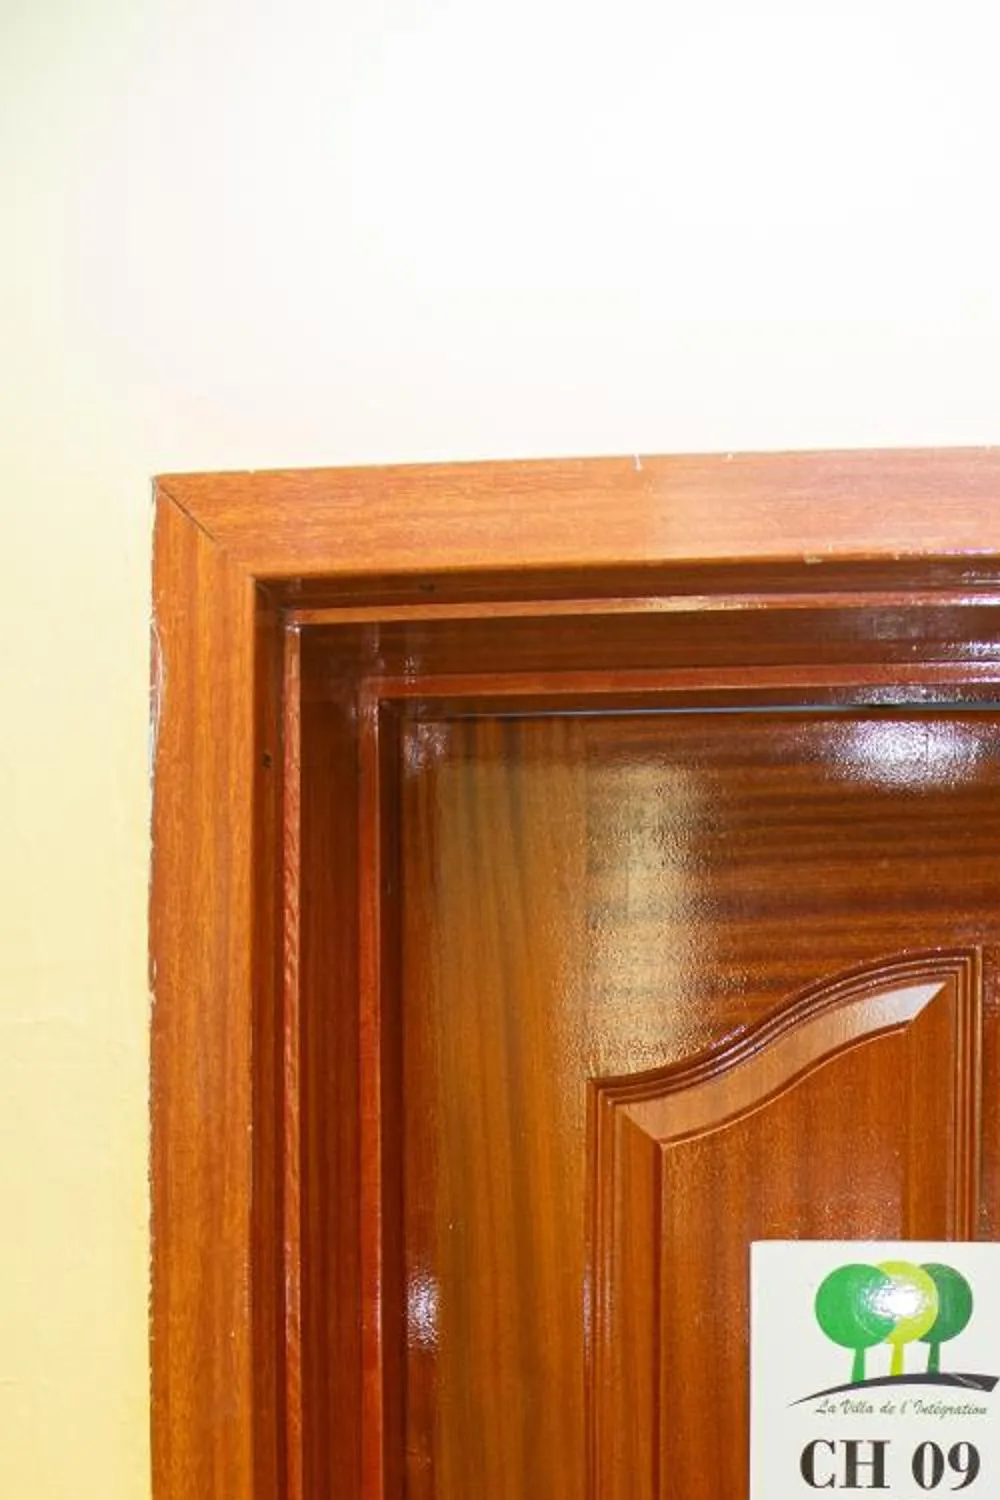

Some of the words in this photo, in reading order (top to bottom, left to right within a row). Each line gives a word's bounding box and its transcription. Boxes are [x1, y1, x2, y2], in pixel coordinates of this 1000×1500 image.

[815, 1399, 837, 1415] La
[839, 1398, 874, 1415] Villa
[879, 1400, 895, 1415] de
[800, 1438, 891, 1489] CH
[911, 1440, 981, 1491] 09
